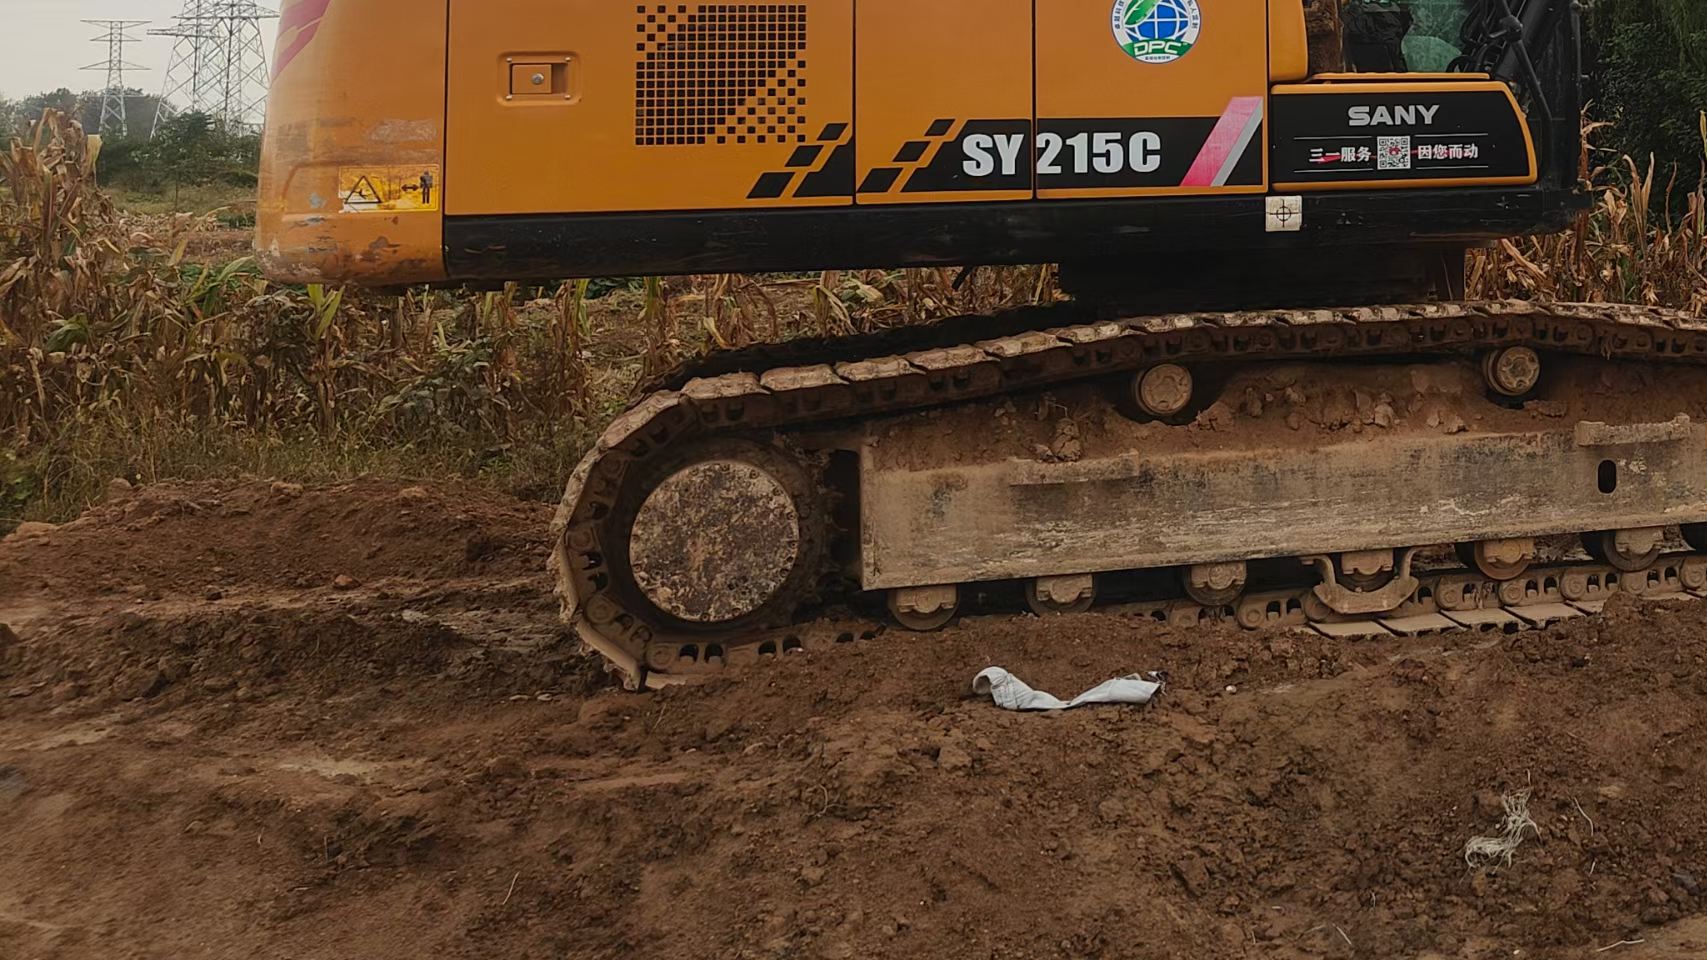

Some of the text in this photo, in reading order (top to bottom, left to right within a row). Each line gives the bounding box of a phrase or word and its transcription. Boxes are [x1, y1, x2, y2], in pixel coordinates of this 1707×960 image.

[1134, 41, 1181, 55] DPC
[1347, 104, 1440, 126] SANY
[1035, 131, 1161, 174] 215C
[1308, 143, 1479, 163] 三一服务 因您而动
